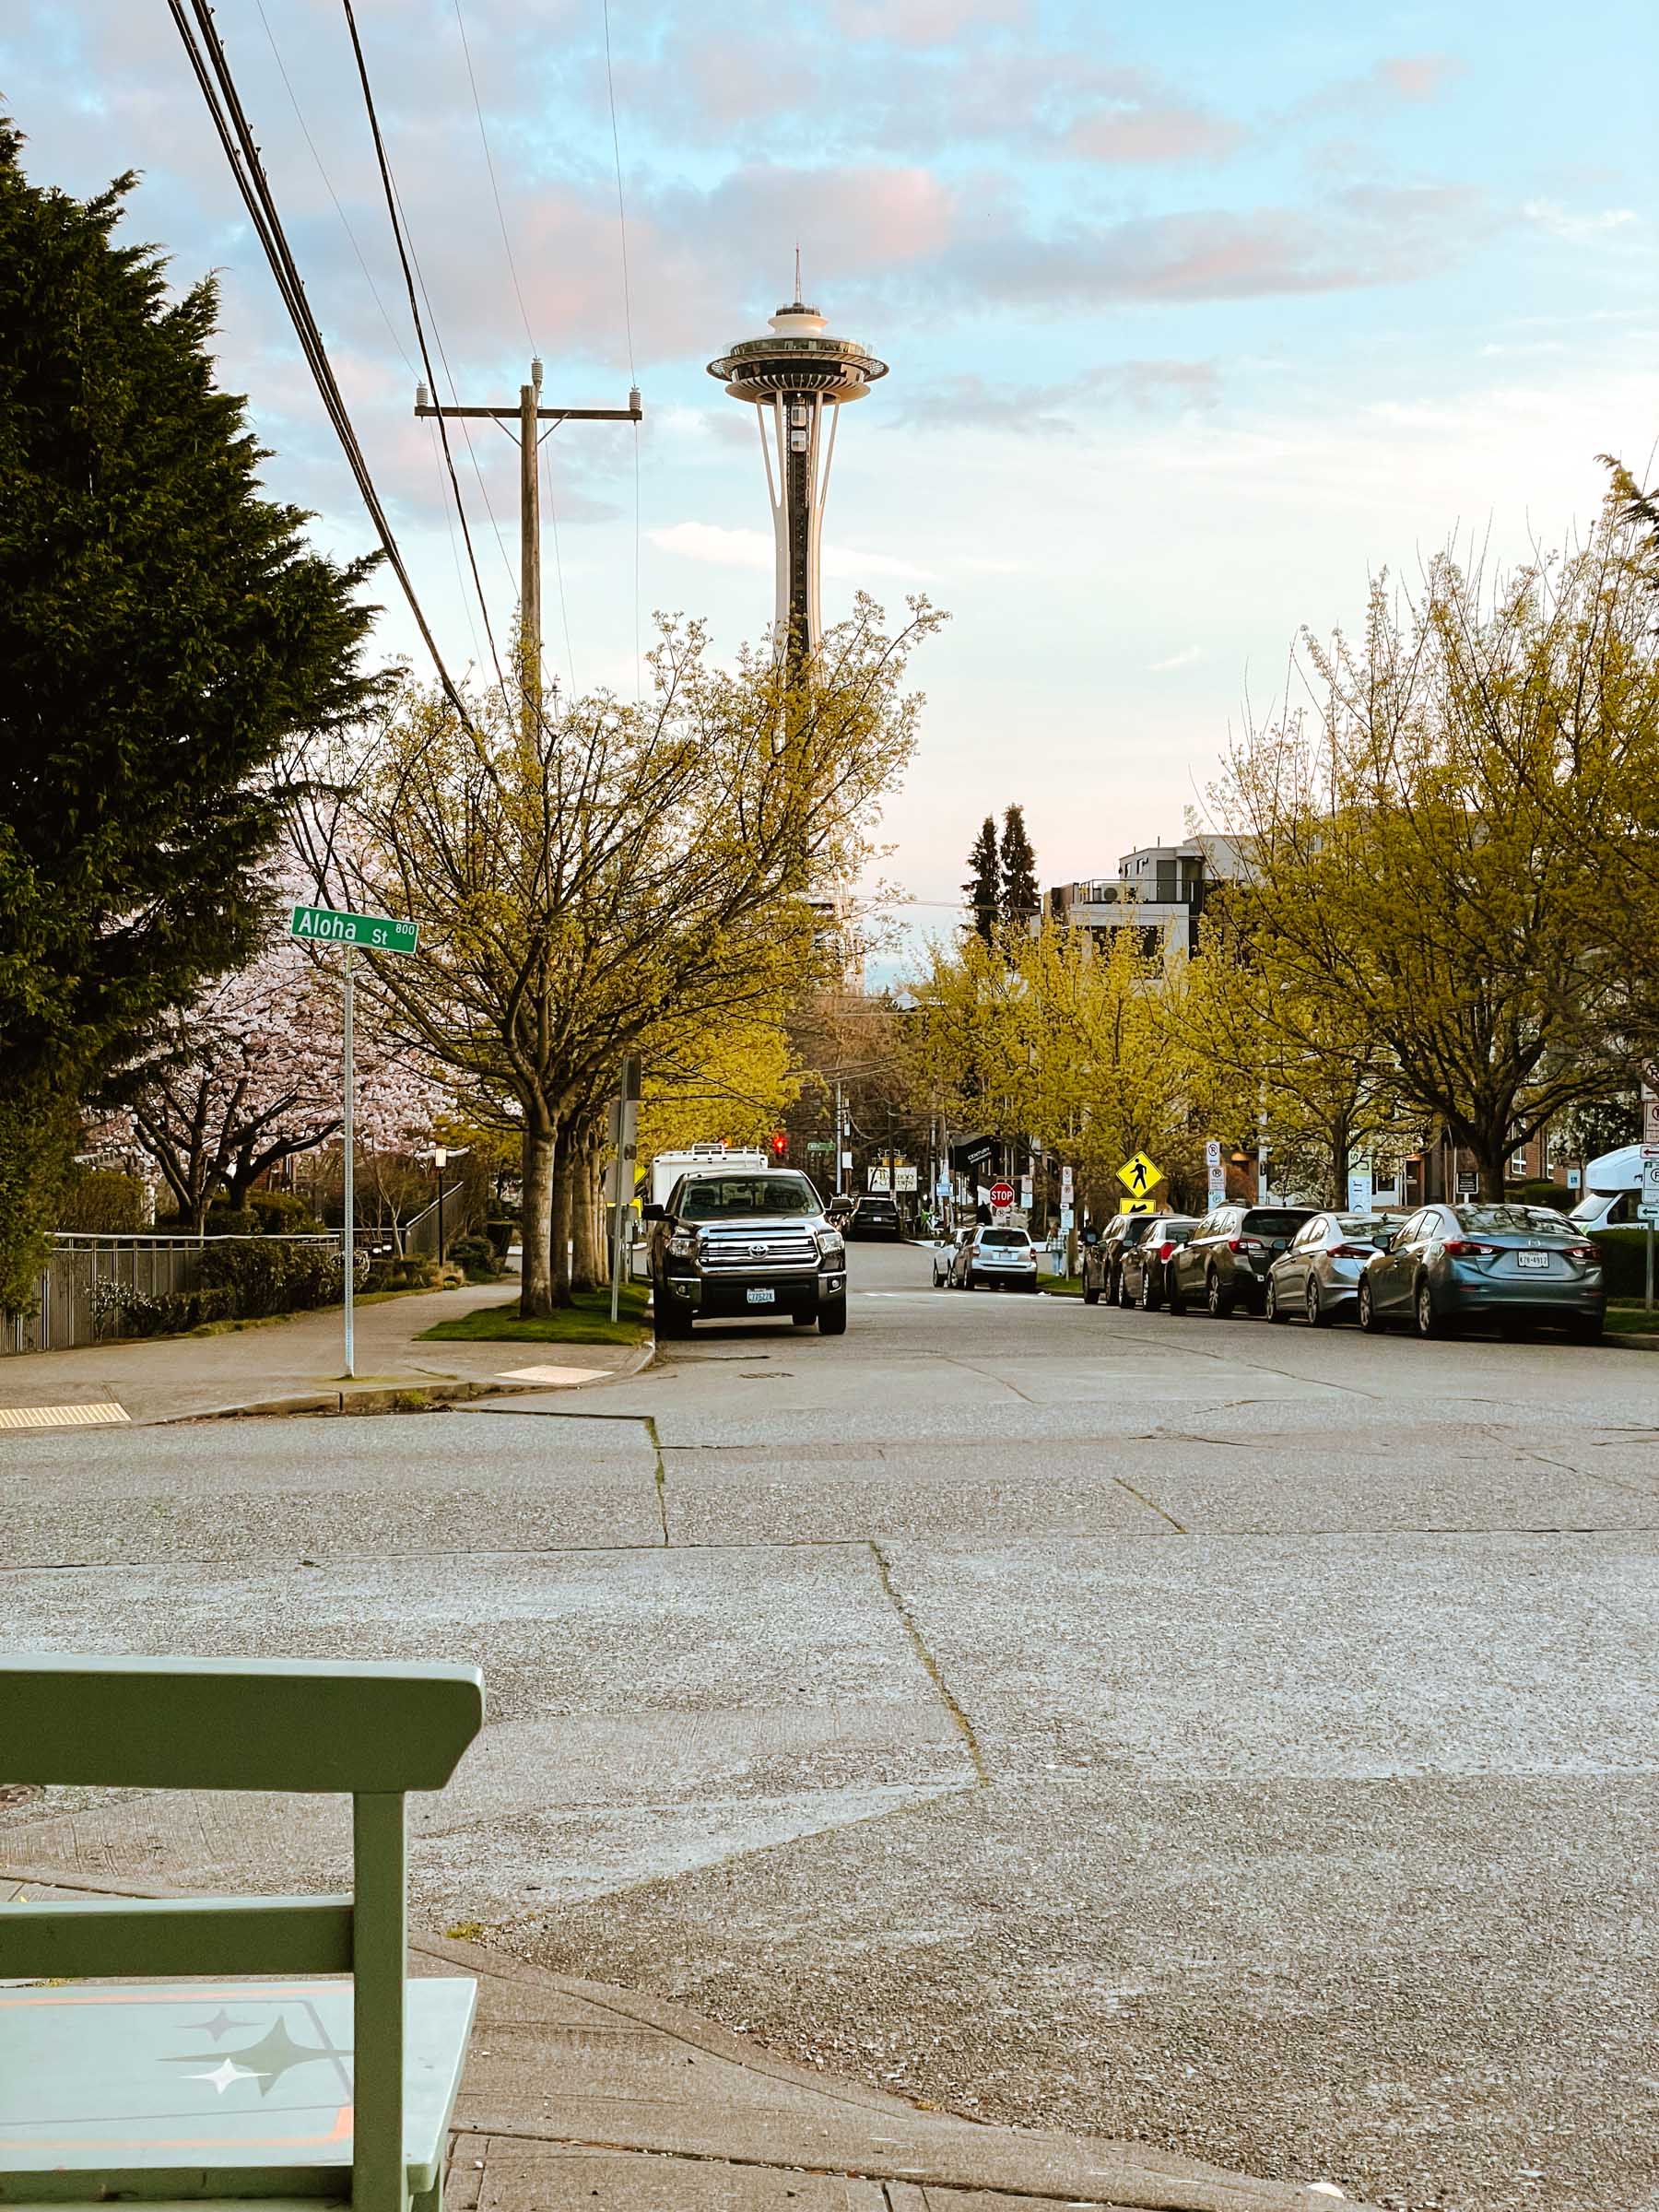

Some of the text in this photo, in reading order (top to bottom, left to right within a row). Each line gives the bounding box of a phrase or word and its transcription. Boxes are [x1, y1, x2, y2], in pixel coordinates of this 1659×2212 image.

[298, 912, 415, 946] Aloha St 800
[991, 1191, 1012, 1200] STOP
